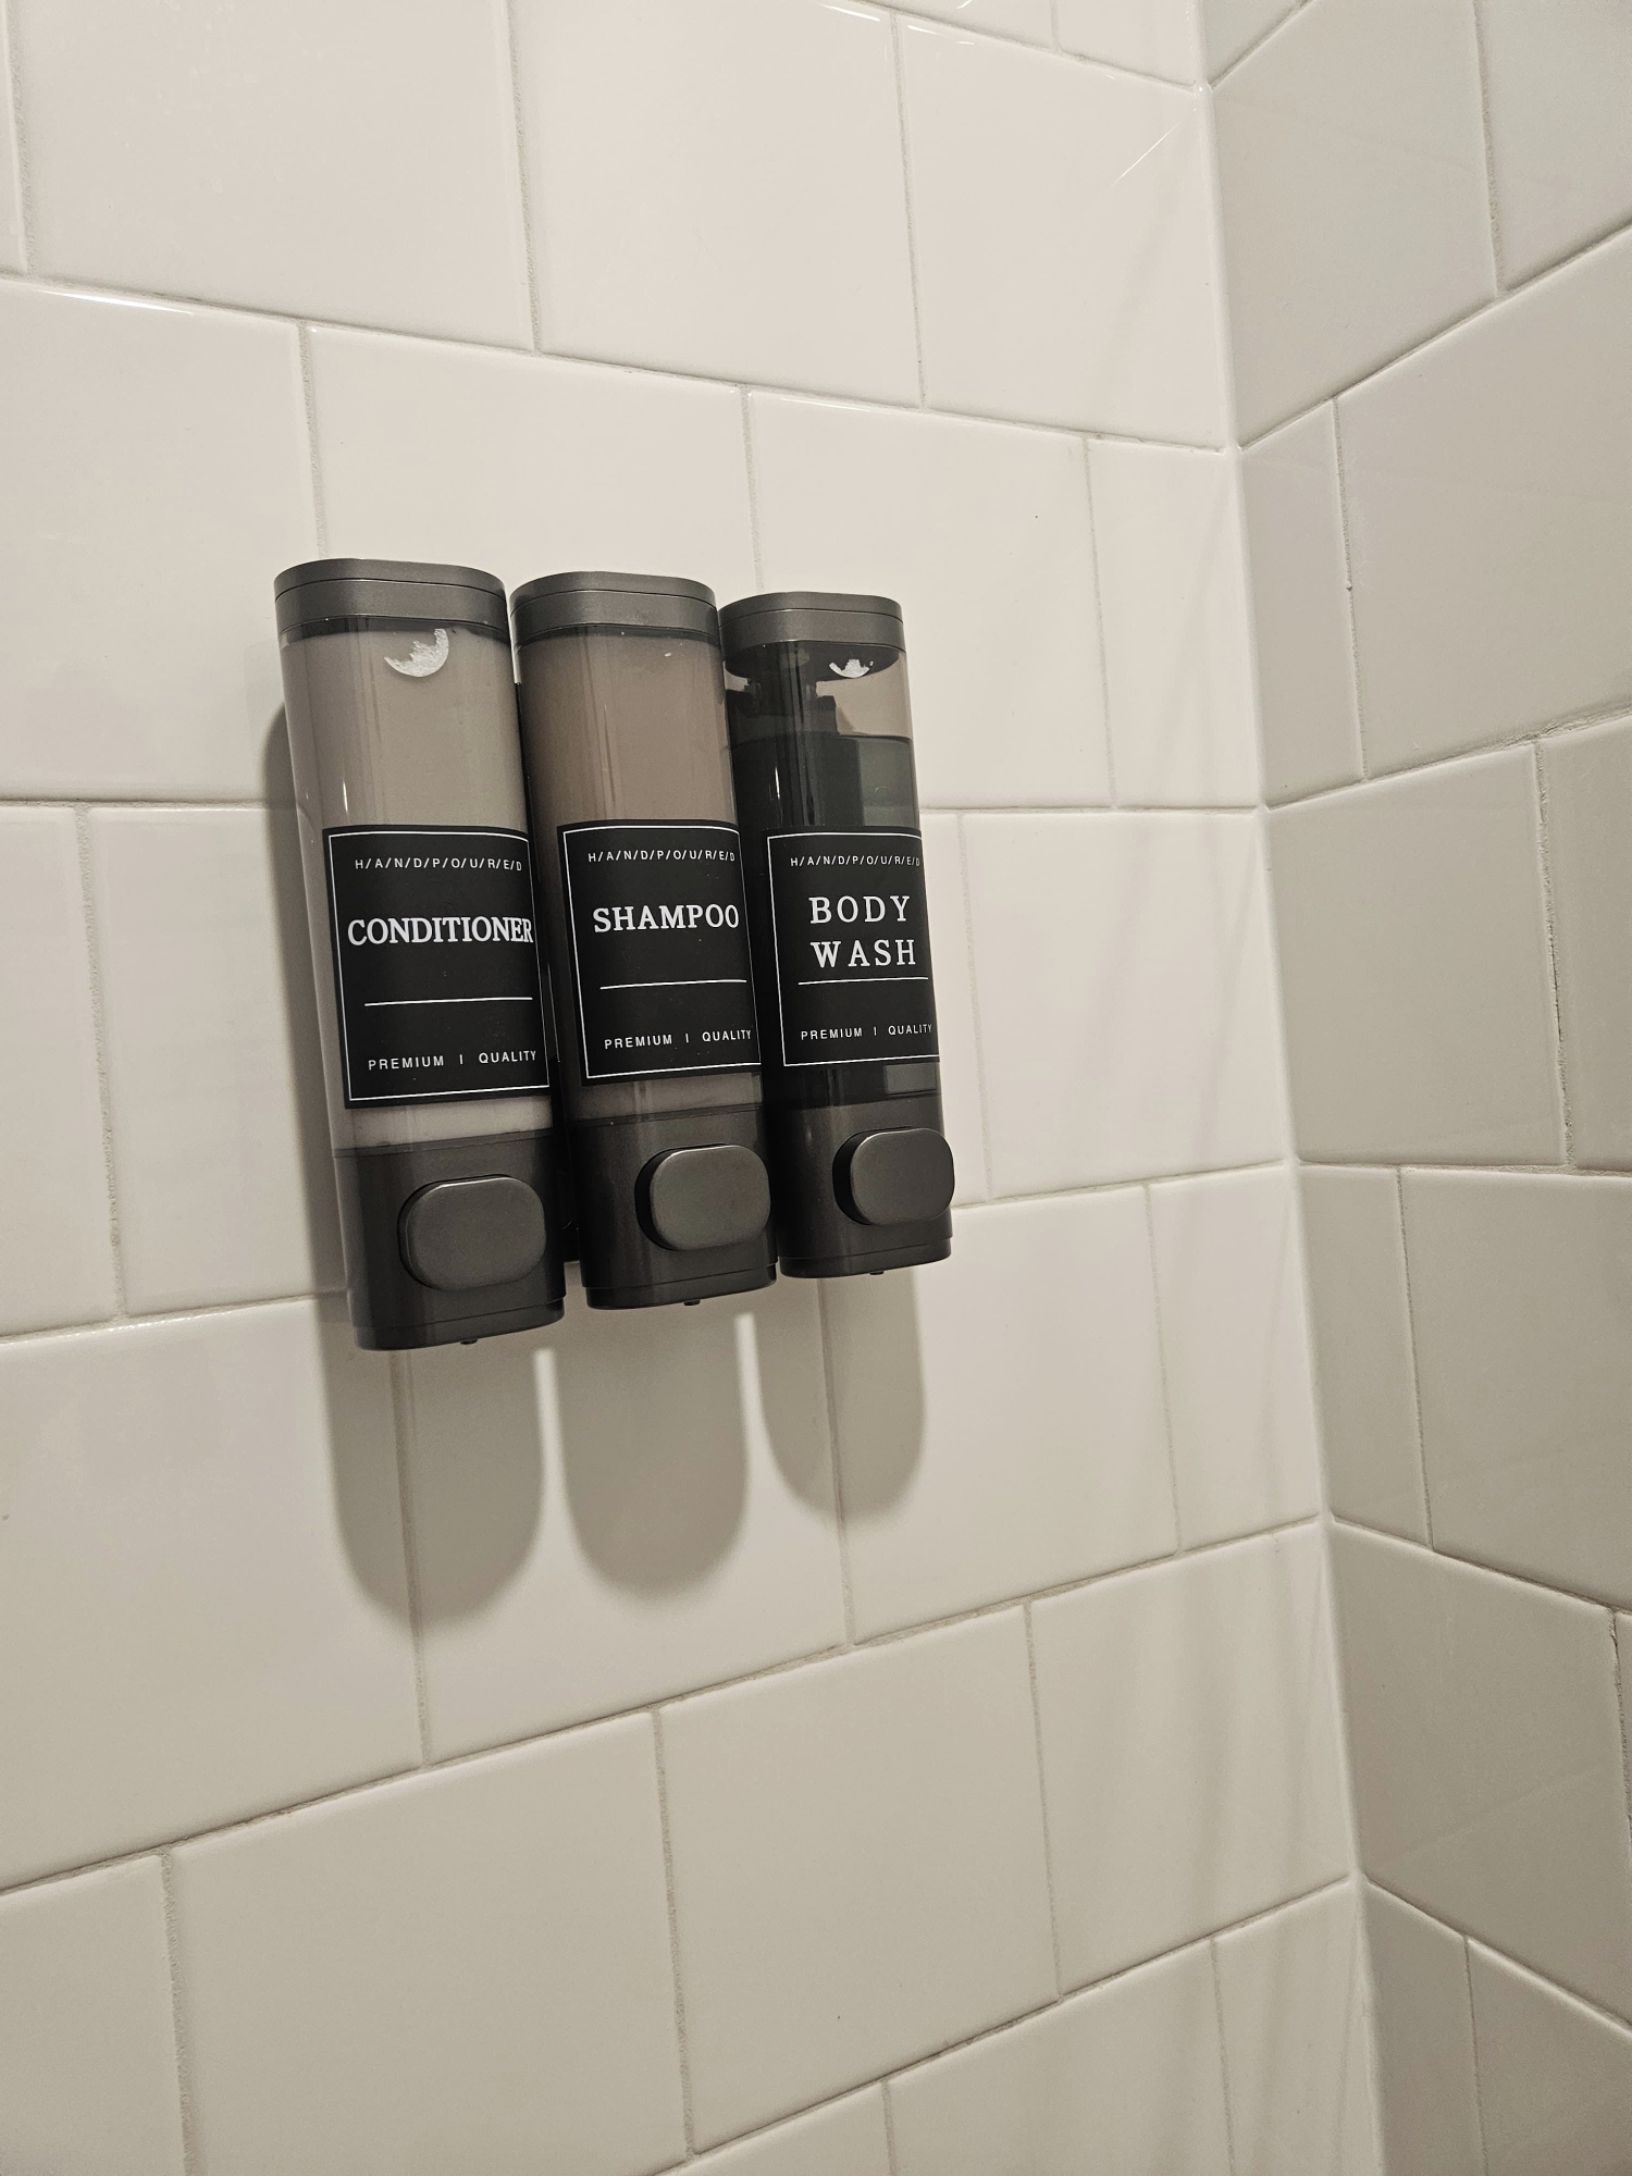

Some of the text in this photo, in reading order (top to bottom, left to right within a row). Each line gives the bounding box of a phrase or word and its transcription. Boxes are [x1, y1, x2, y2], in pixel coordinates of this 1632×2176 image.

[355, 857, 522, 872] H/A/N/D/P/O/U/R/E/D
[592, 903, 740, 933] SHAMPOO
[808, 895, 911, 924] BODY
[347, 915, 534, 946] CONDITIONER
[810, 939, 916, 968] WASH
[604, 1034, 673, 1050] PREMIUM
[702, 1029, 752, 1043] QUALITY
[801, 1027, 863, 1041] PREMIUM
[888, 1023, 933, 1036] QUALITY
[368, 1055, 445, 1071] PREMIUM
[478, 1050, 537, 1065] QUALITY
